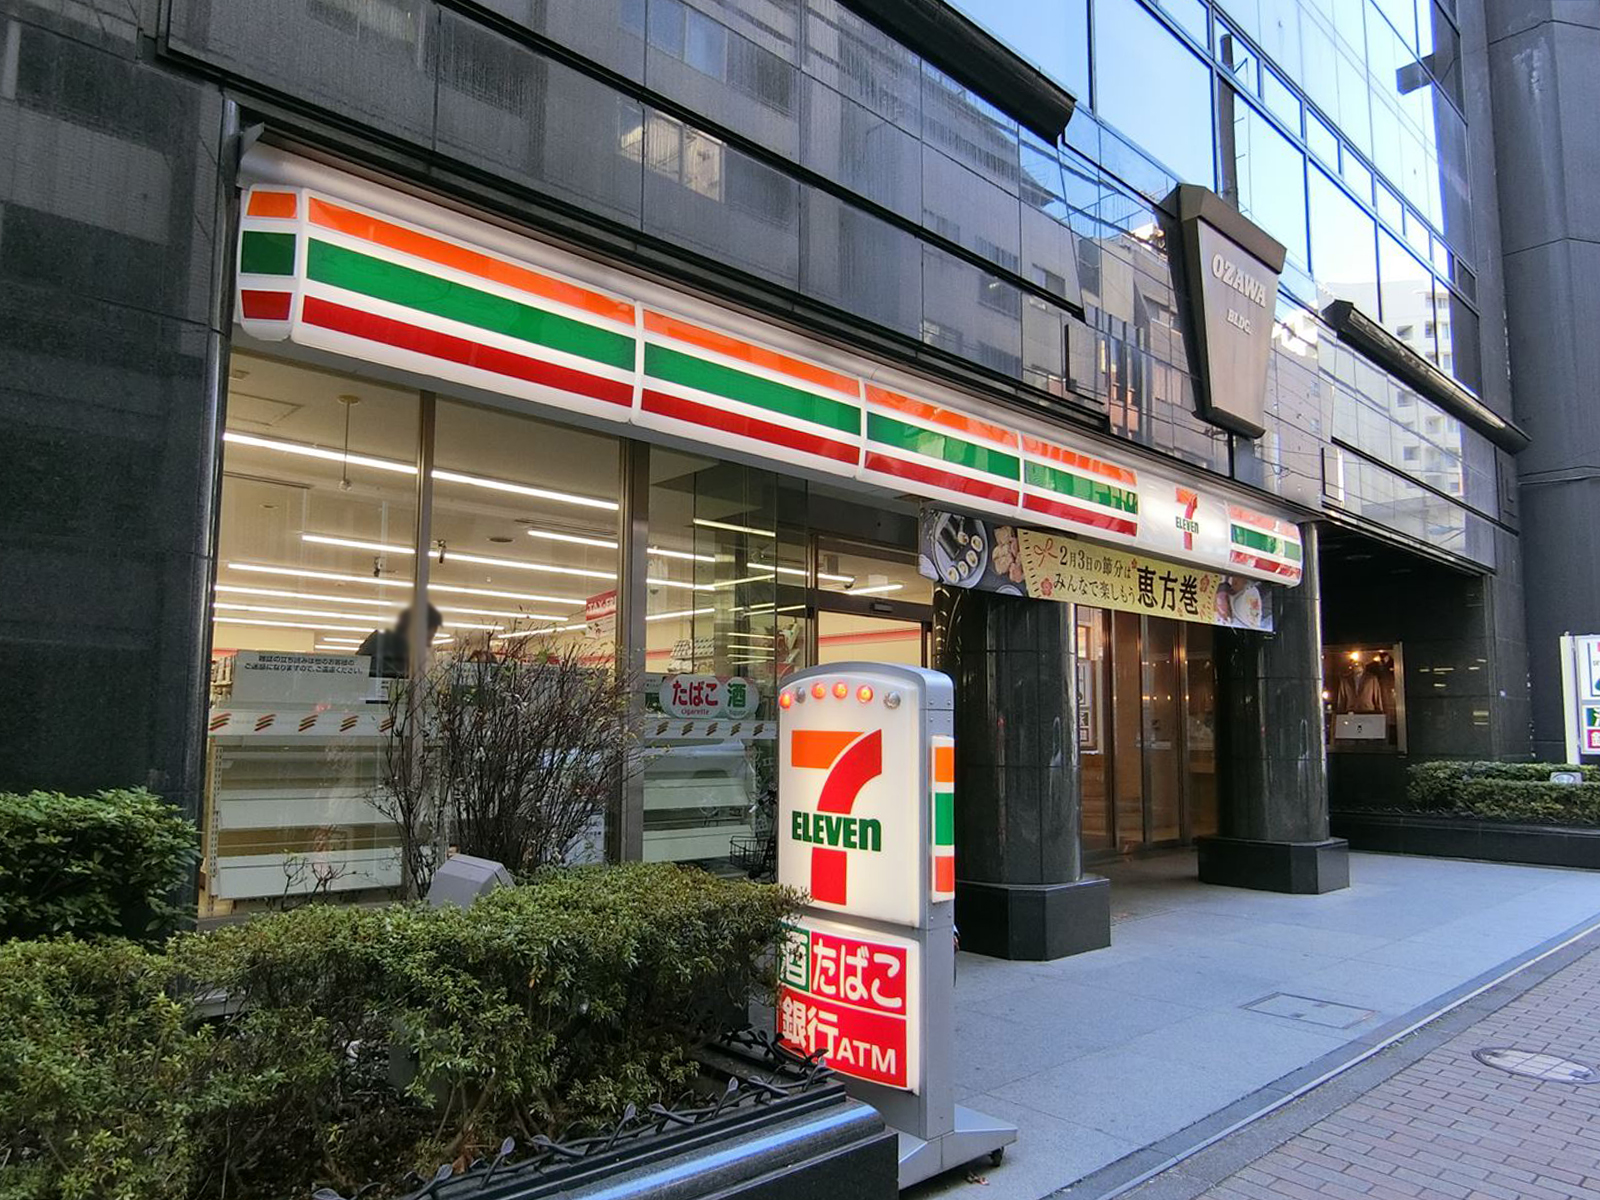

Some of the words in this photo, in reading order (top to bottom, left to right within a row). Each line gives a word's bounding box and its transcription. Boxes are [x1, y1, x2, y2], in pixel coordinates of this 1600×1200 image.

[1212, 254, 1266, 308] OZAWA
[1059, 545, 1131, 579] 2月3日の節分は
[1054, 573, 1136, 605] みんなで楽しもう
[1137, 566, 1199, 615] 恵方巻
[672, 681, 718, 706] たばこ
[727, 683, 746, 707] 酒
[780, 930, 808, 987] 酒
[813, 938, 902, 1008] たばこ
